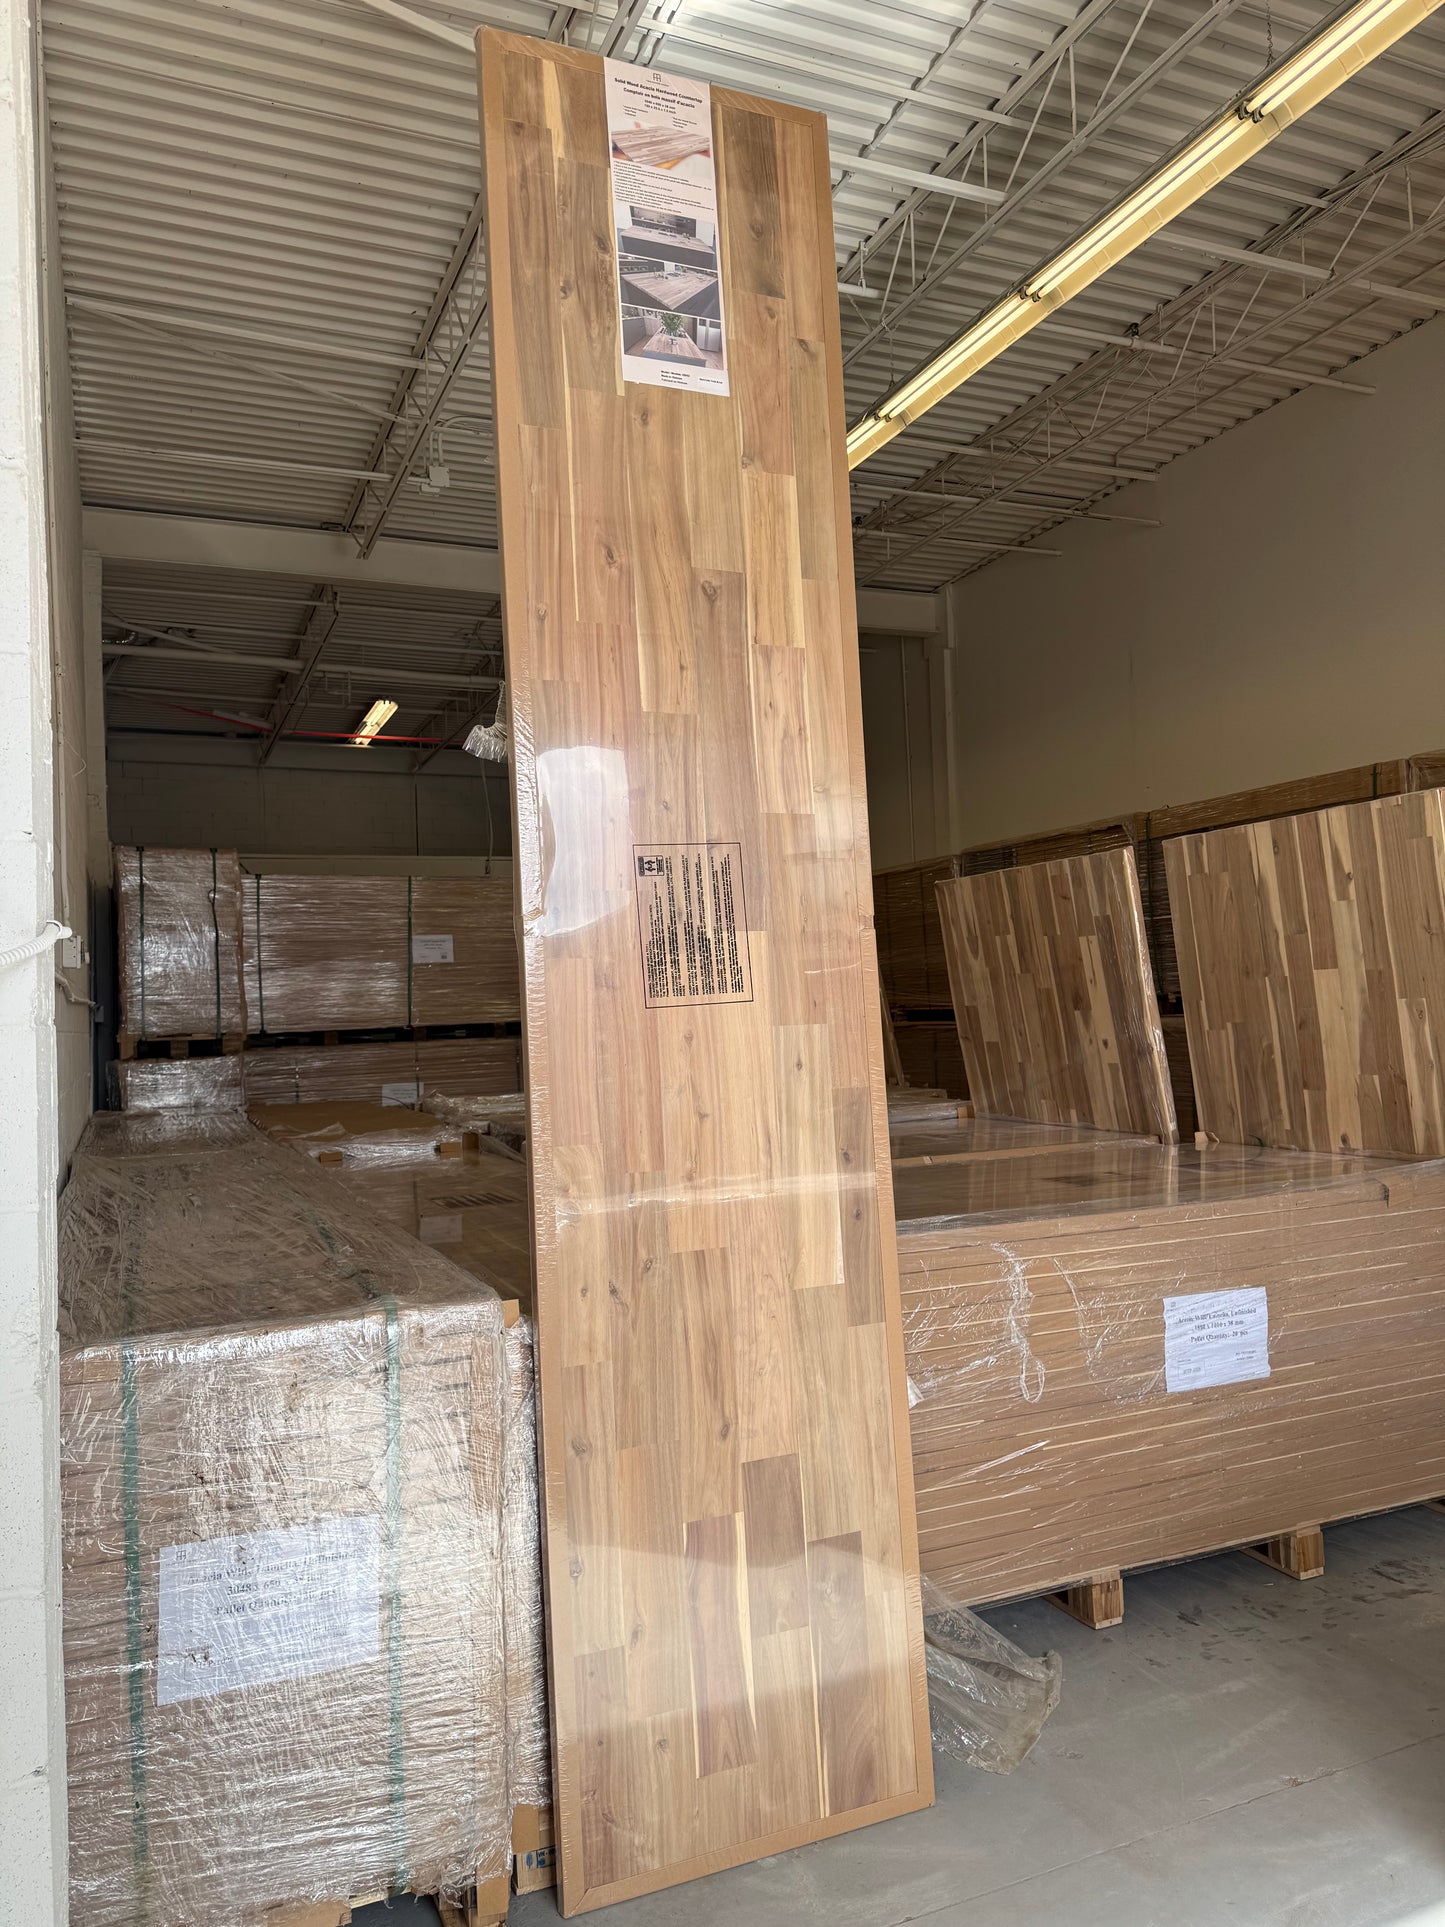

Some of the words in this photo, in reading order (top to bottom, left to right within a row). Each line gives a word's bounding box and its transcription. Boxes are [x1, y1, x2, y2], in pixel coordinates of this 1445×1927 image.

[640, 84, 655, 92] Acacia
[656, 88, 678, 97] Hardwood
[678, 93, 703, 104] Countertop
[227, 1584, 251, 1595] 3048
[216, 1603, 246, 1615] Pallet
